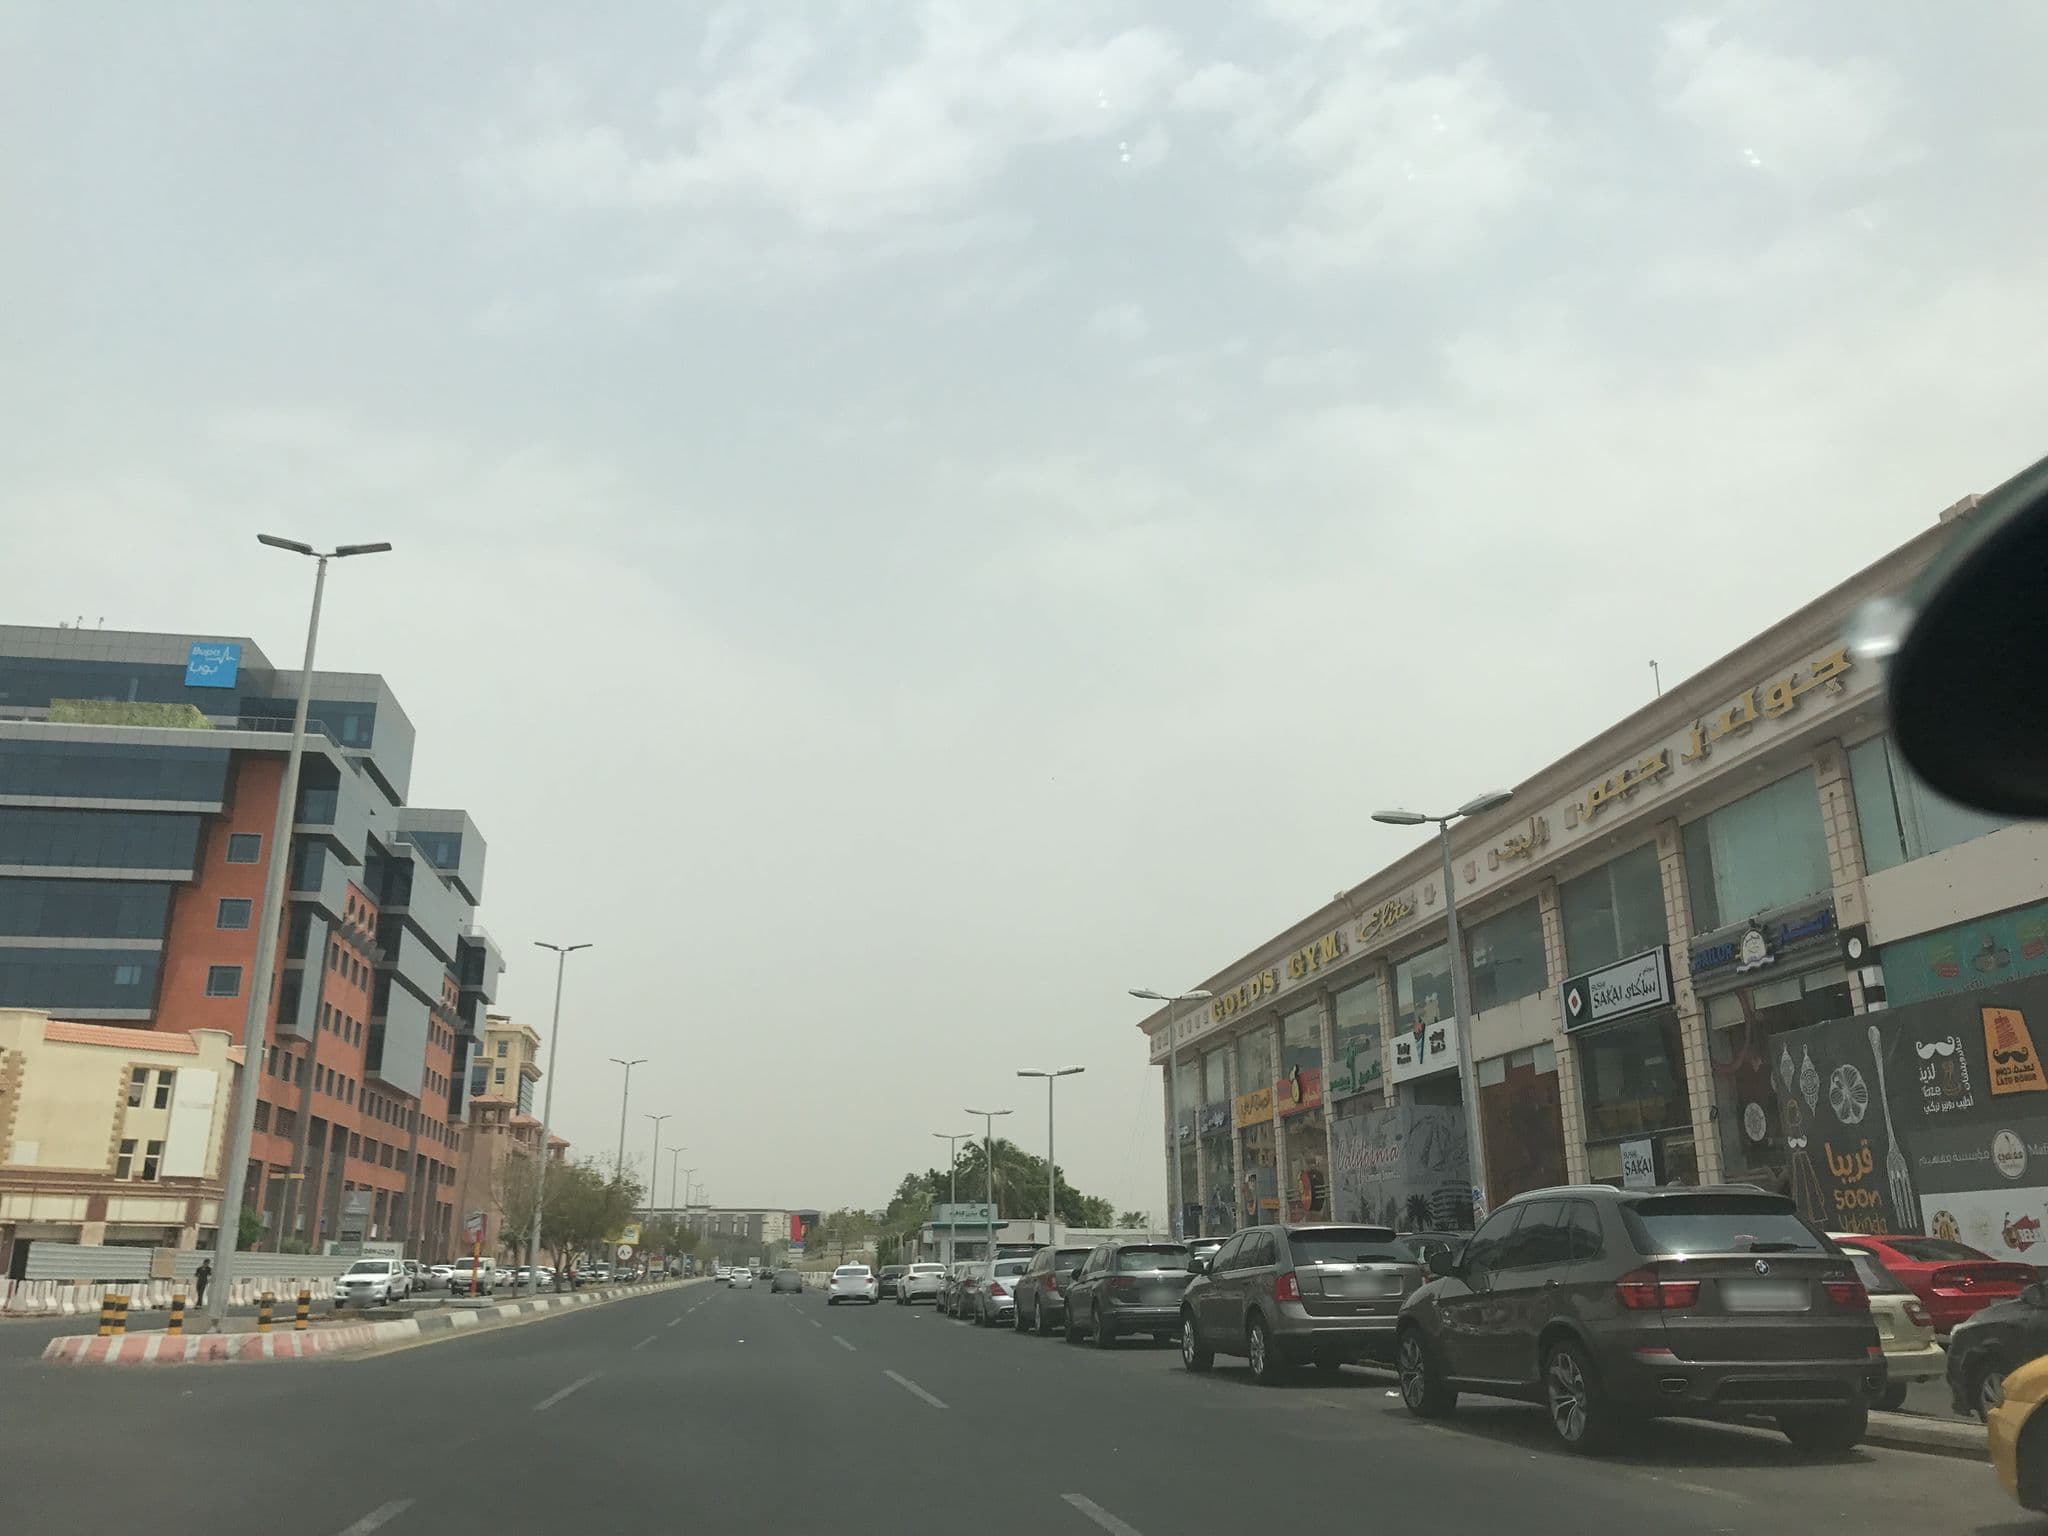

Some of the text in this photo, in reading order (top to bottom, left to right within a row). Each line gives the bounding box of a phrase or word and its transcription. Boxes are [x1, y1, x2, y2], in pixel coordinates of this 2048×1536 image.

[192, 646, 220, 656] Bupa
[1288, 931, 1340, 978] GYM
[1593, 984, 1623, 1009] SAKAI
[1624, 1156, 1653, 1177] SAKAI
